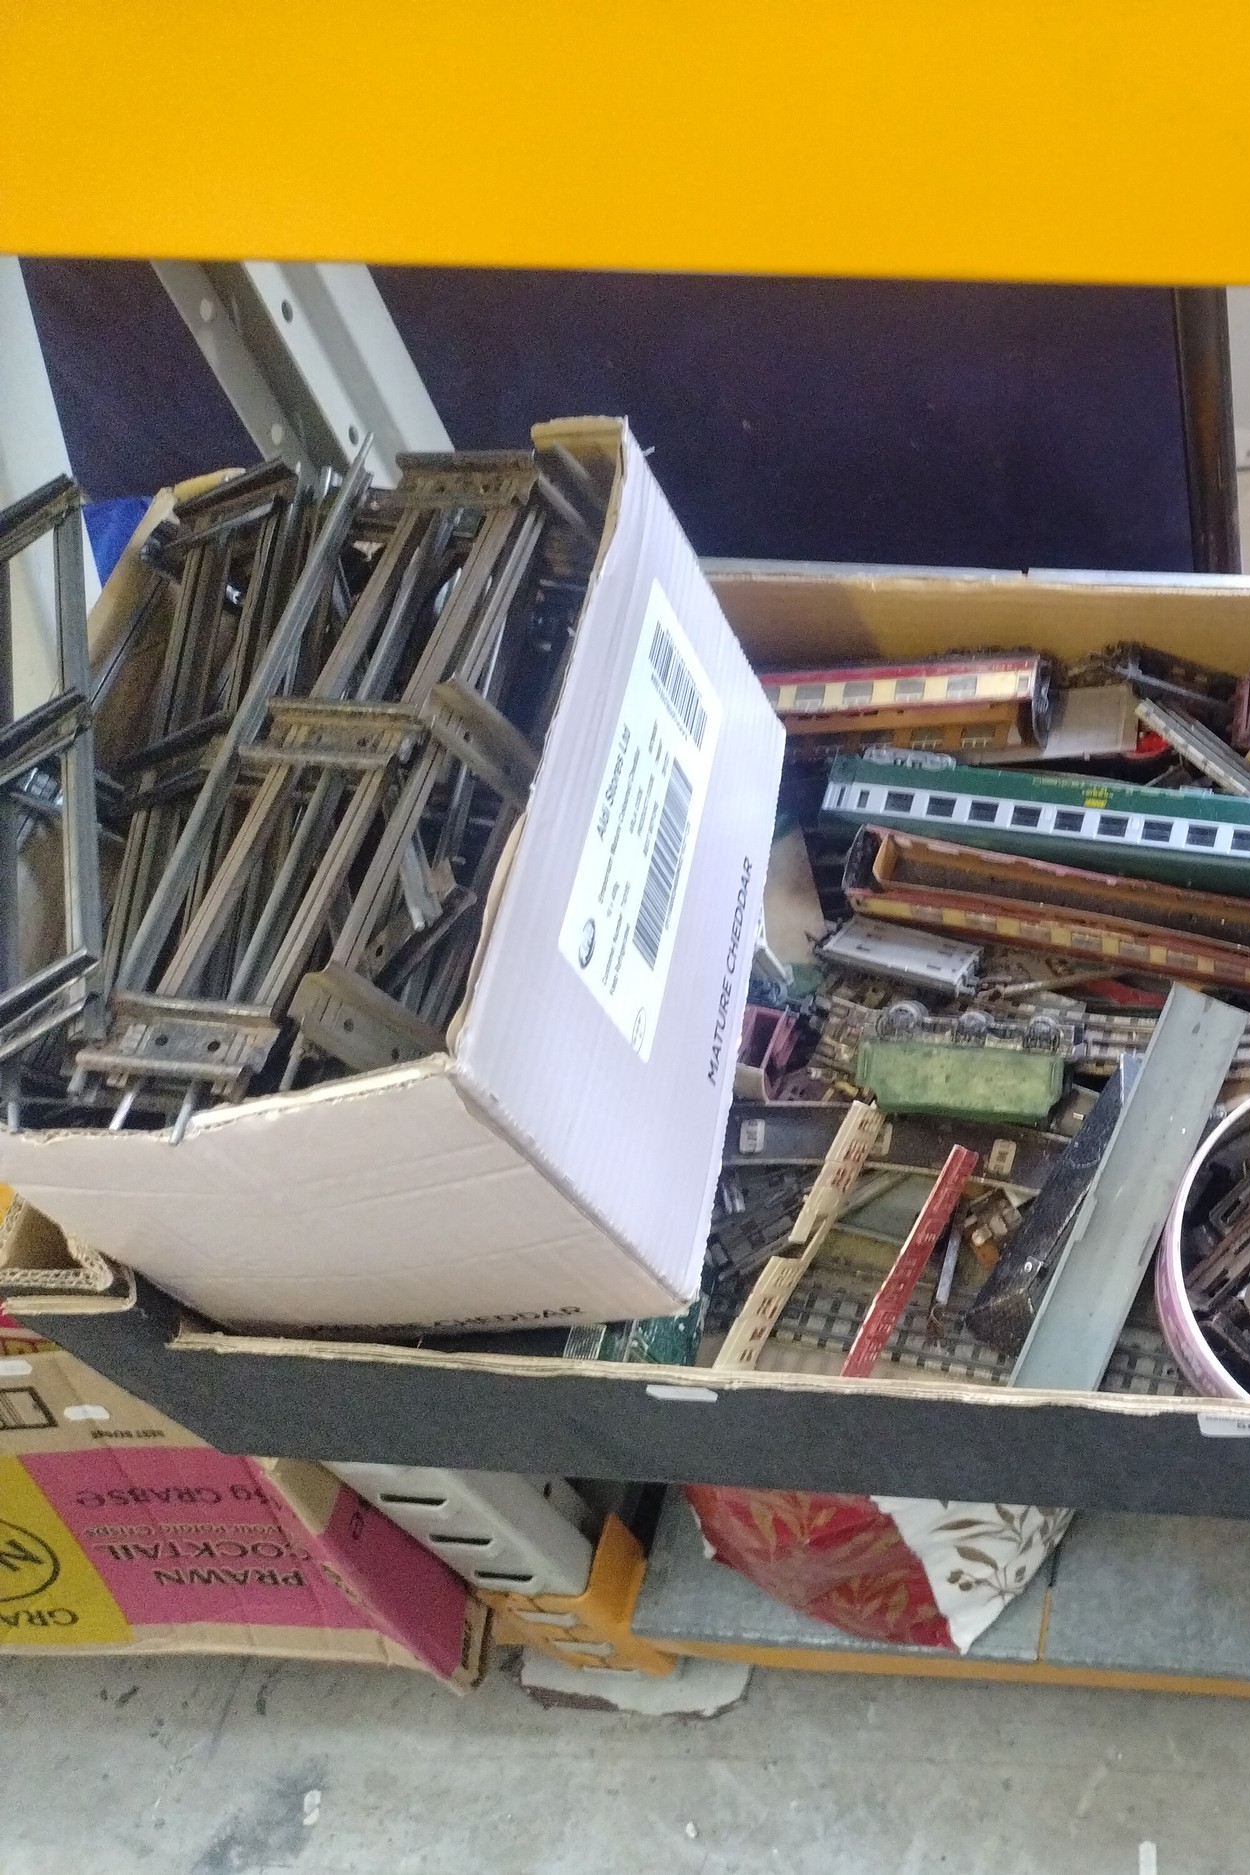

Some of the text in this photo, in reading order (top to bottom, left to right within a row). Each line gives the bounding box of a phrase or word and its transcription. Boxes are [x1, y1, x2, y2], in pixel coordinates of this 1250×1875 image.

[597, 722, 630, 842] Aldi Stores Ltd
[708, 855, 753, 1086] MATURE CHEDDAR
[107, 1485, 222, 1506] GRABS
[94, 1541, 312, 1563] COCKTAIL
[154, 1567, 305, 1587] PRAWN
